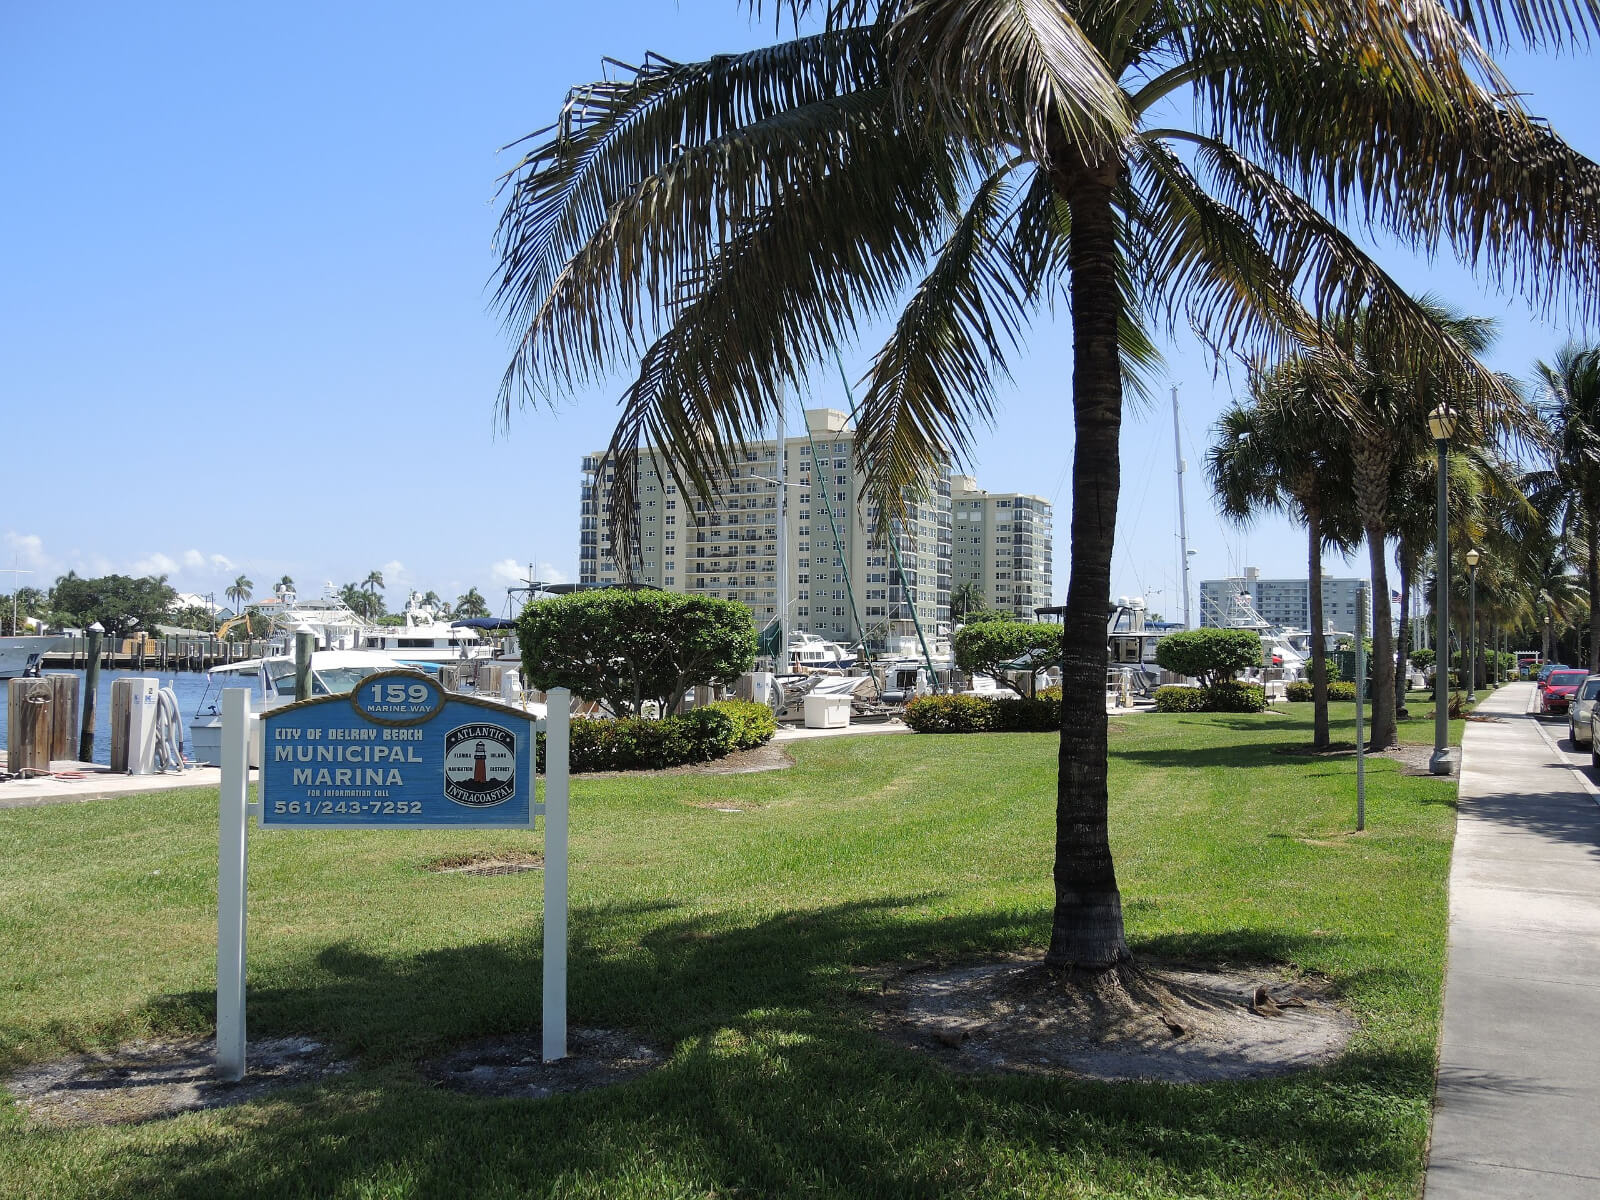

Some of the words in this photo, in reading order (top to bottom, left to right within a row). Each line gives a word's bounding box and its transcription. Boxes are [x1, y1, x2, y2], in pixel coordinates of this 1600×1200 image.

[371, 684, 429, 703] 159
[367, 705, 406, 713] MARINE
[408, 705, 432, 713] WAY
[275, 729, 301, 740] CITY
[306, 729, 322, 740] OF
[328, 729, 377, 741] DELRAY
[383, 729, 423, 741] BEACH
[457, 727, 505, 741] ATLANTIC
[275, 746, 423, 763] MUNICIPAL
[293, 768, 403, 786] MARINA
[447, 784, 513, 803] INTRACOASTAL
[274, 801, 422, 814] 561/243-7252
